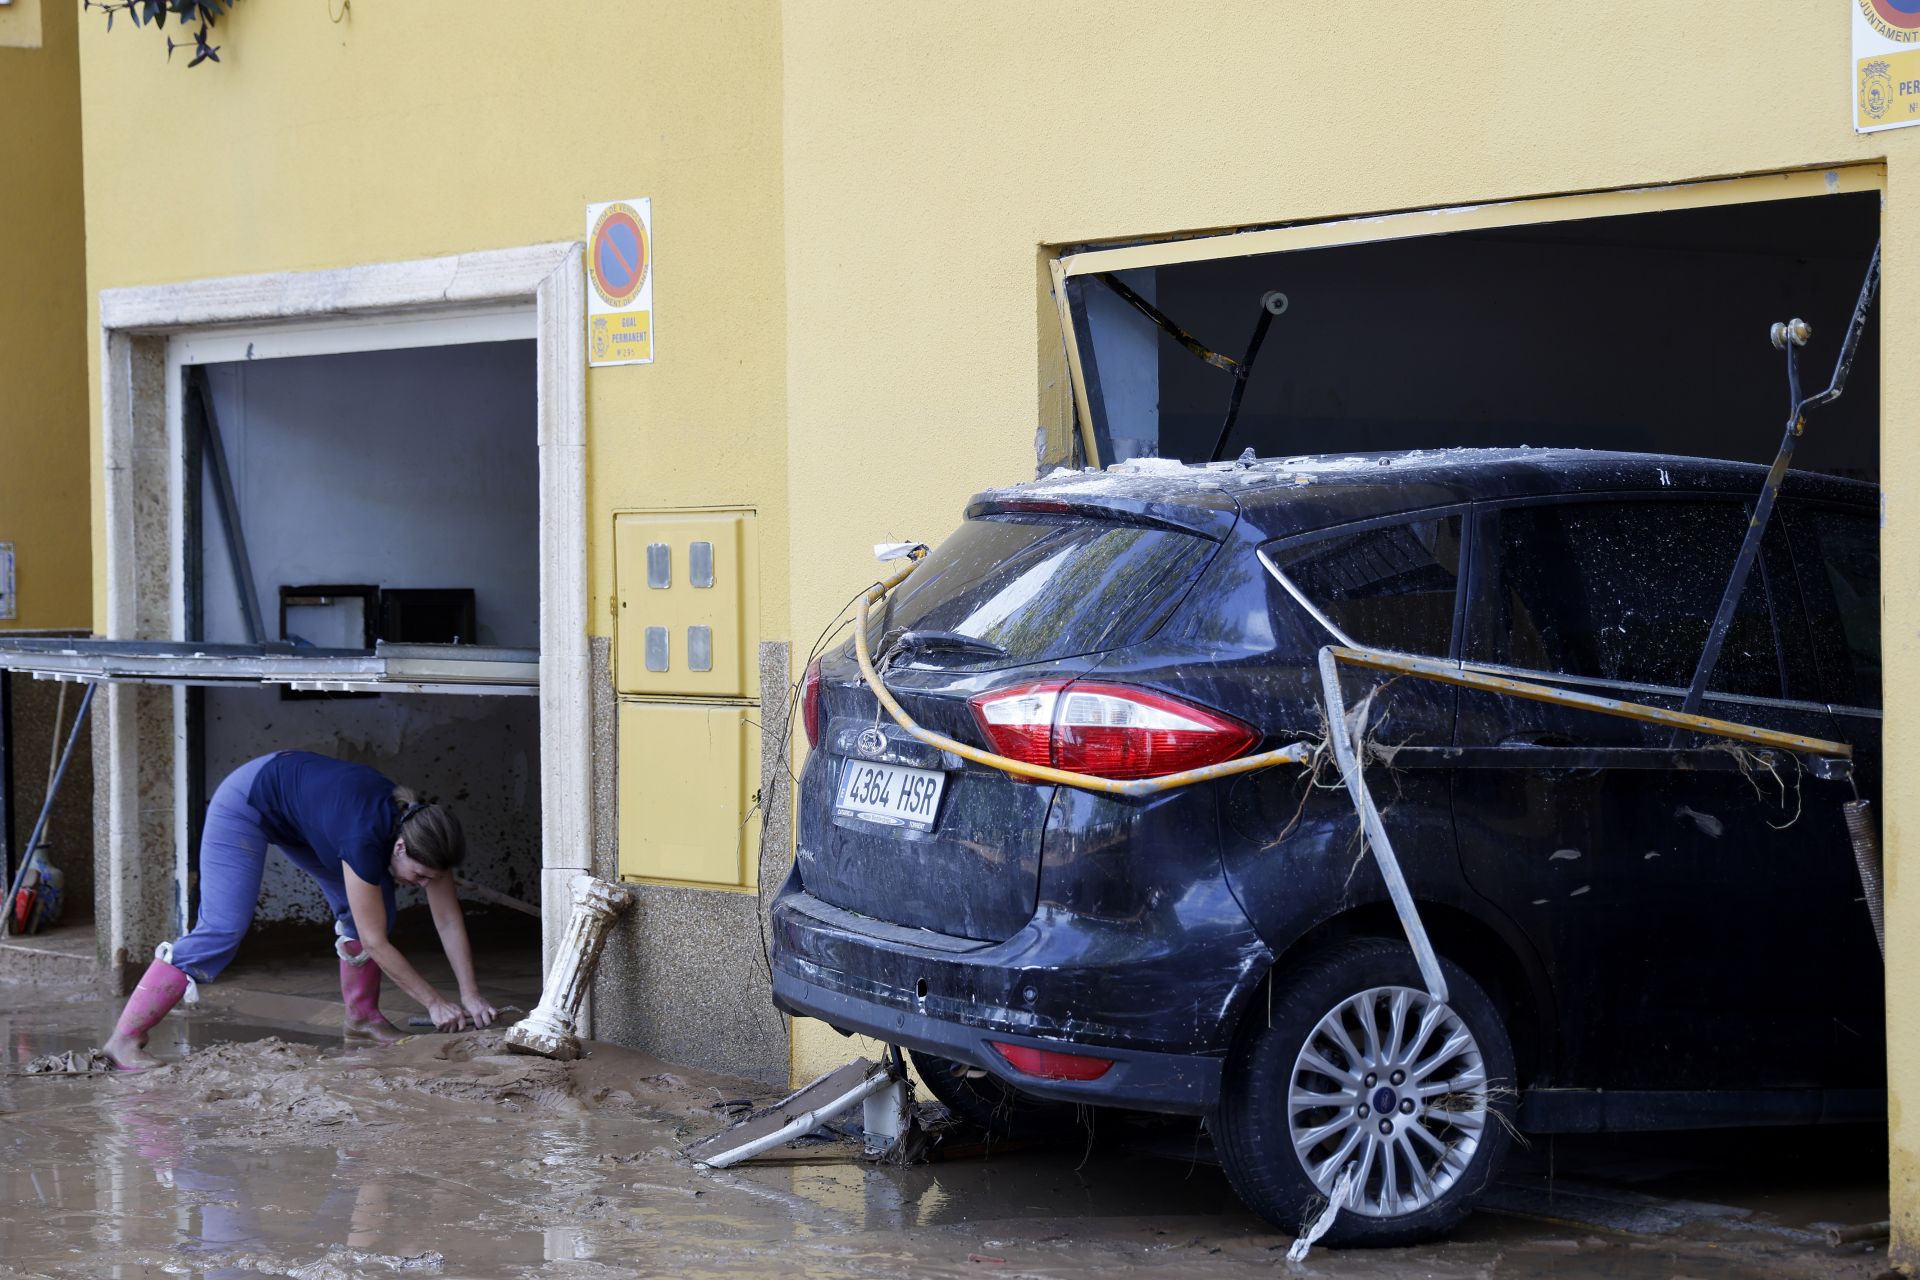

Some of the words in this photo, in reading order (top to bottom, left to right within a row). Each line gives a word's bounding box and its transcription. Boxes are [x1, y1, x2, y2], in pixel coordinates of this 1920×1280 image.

[621, 317, 637, 328] GUAL
[612, 331, 647, 344] PERMANENT
[849, 767, 894, 808] 4364
[896, 773, 937, 816] HSR
